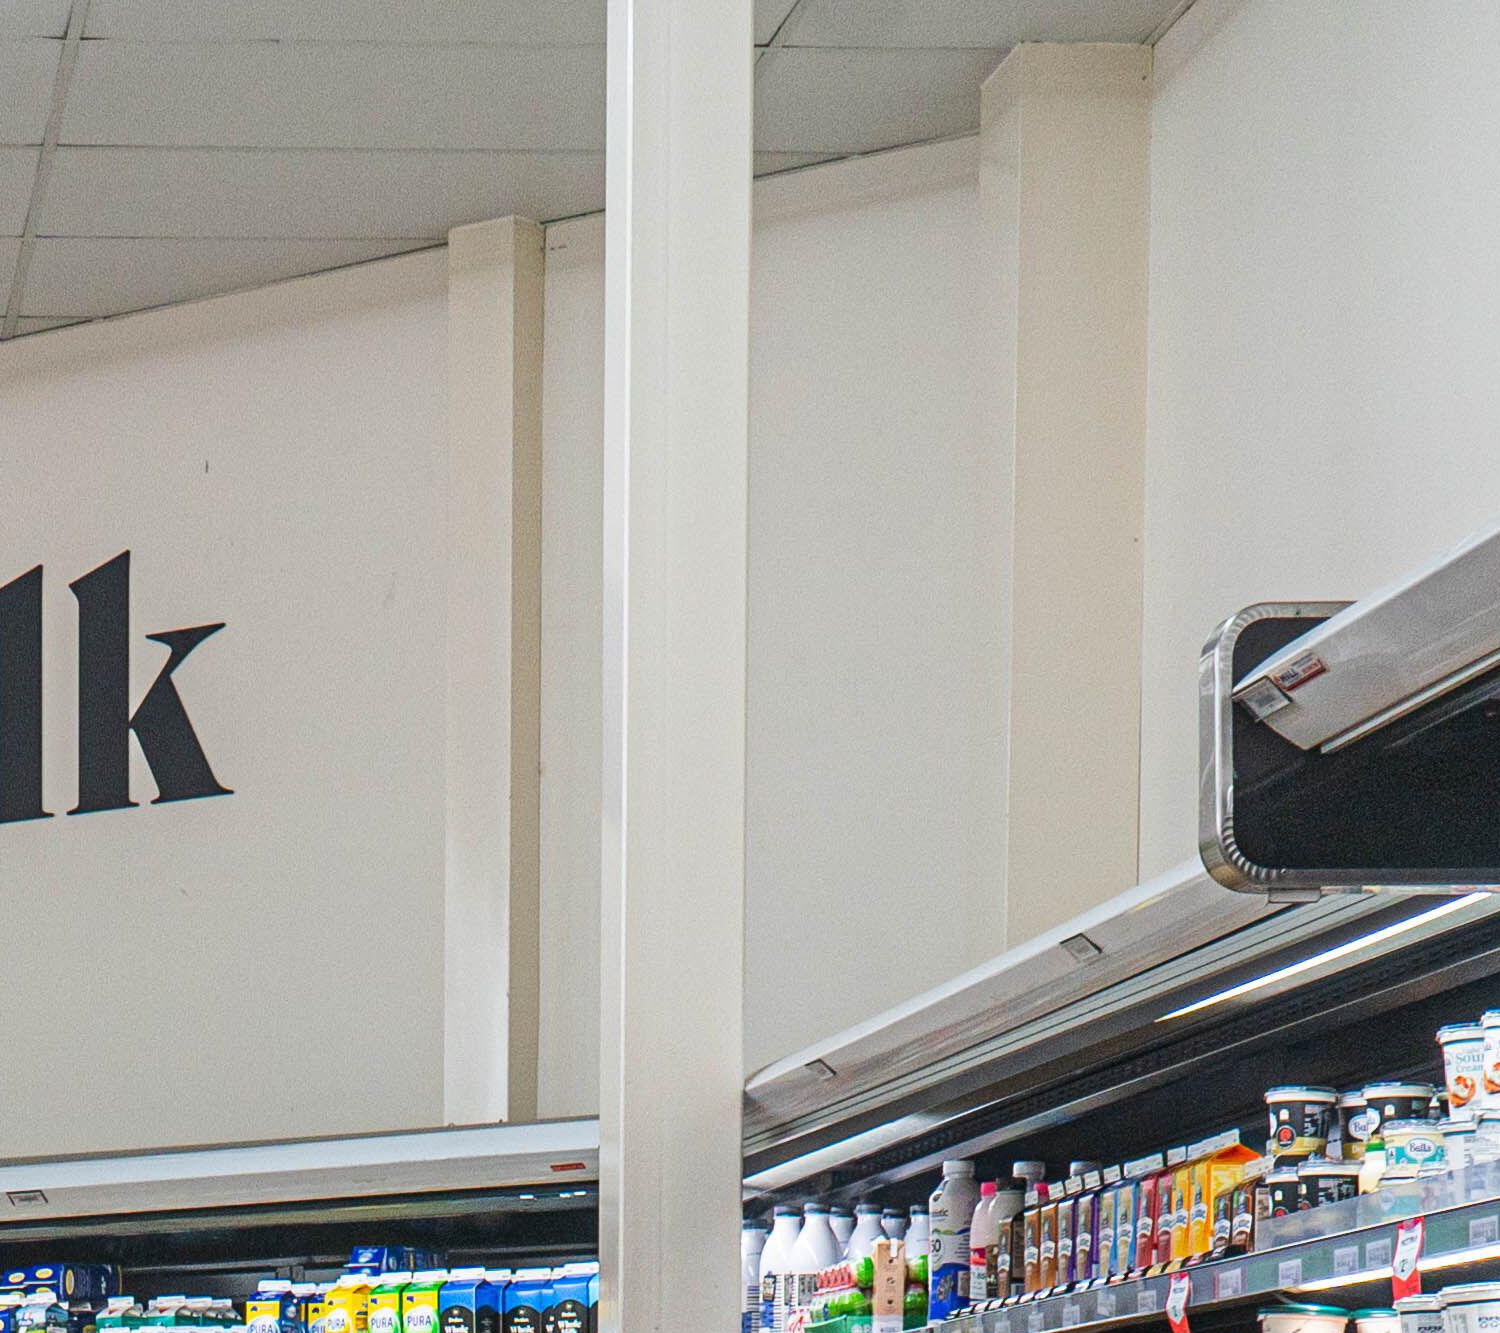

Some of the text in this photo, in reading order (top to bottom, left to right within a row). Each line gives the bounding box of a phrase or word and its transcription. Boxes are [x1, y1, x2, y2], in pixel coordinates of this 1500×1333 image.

[1455, 1049, 1484, 1066] Sou
[327, 1317, 346, 1329] PURA
[371, 1316, 393, 1329] PURA
[406, 1315, 431, 1328] PURA
[557, 1319, 582, 1330] Whole
